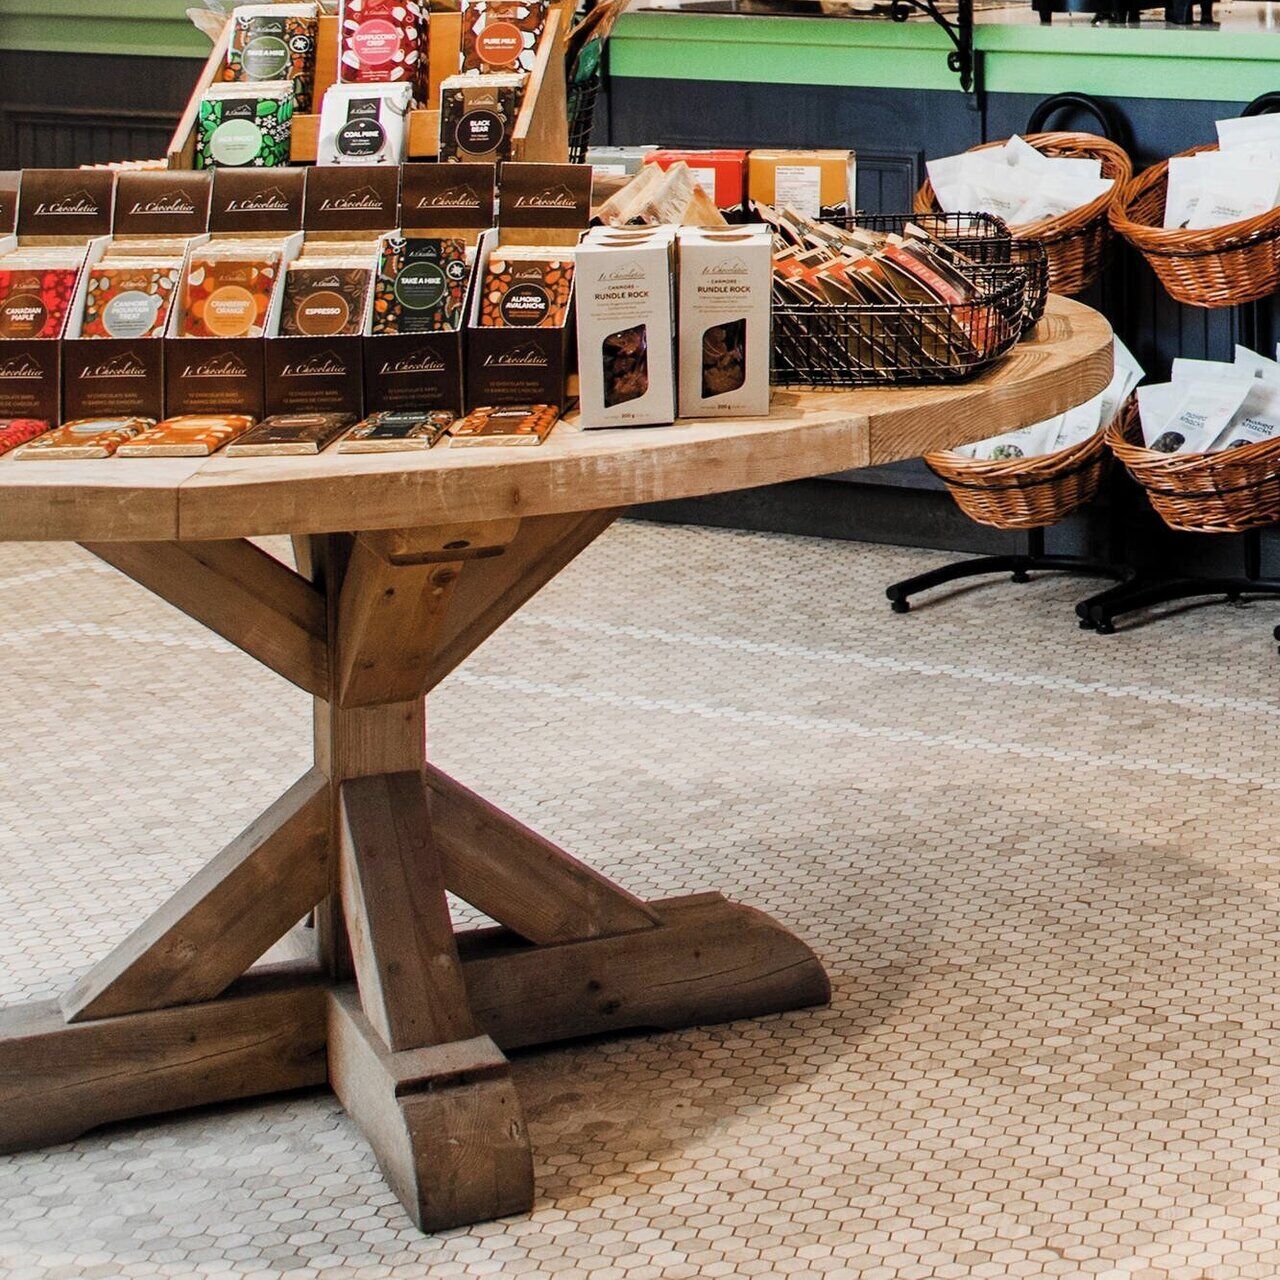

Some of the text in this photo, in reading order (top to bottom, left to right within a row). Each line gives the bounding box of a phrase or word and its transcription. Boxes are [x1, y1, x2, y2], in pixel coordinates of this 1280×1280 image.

[470, 119, 491, 127] BLACK
[697, 285, 751, 294] RUNDLE ROCK
[510, 295, 542, 303] ALMOND
[594, 290, 649, 300] RUNDLE ROCK
[505, 301, 546, 310] AVALANCHE
[5, 306, 42, 315] CANADIAN
[305, 307, 342, 316] ESPRESSO
[10, 313, 35, 321] MAPLE
